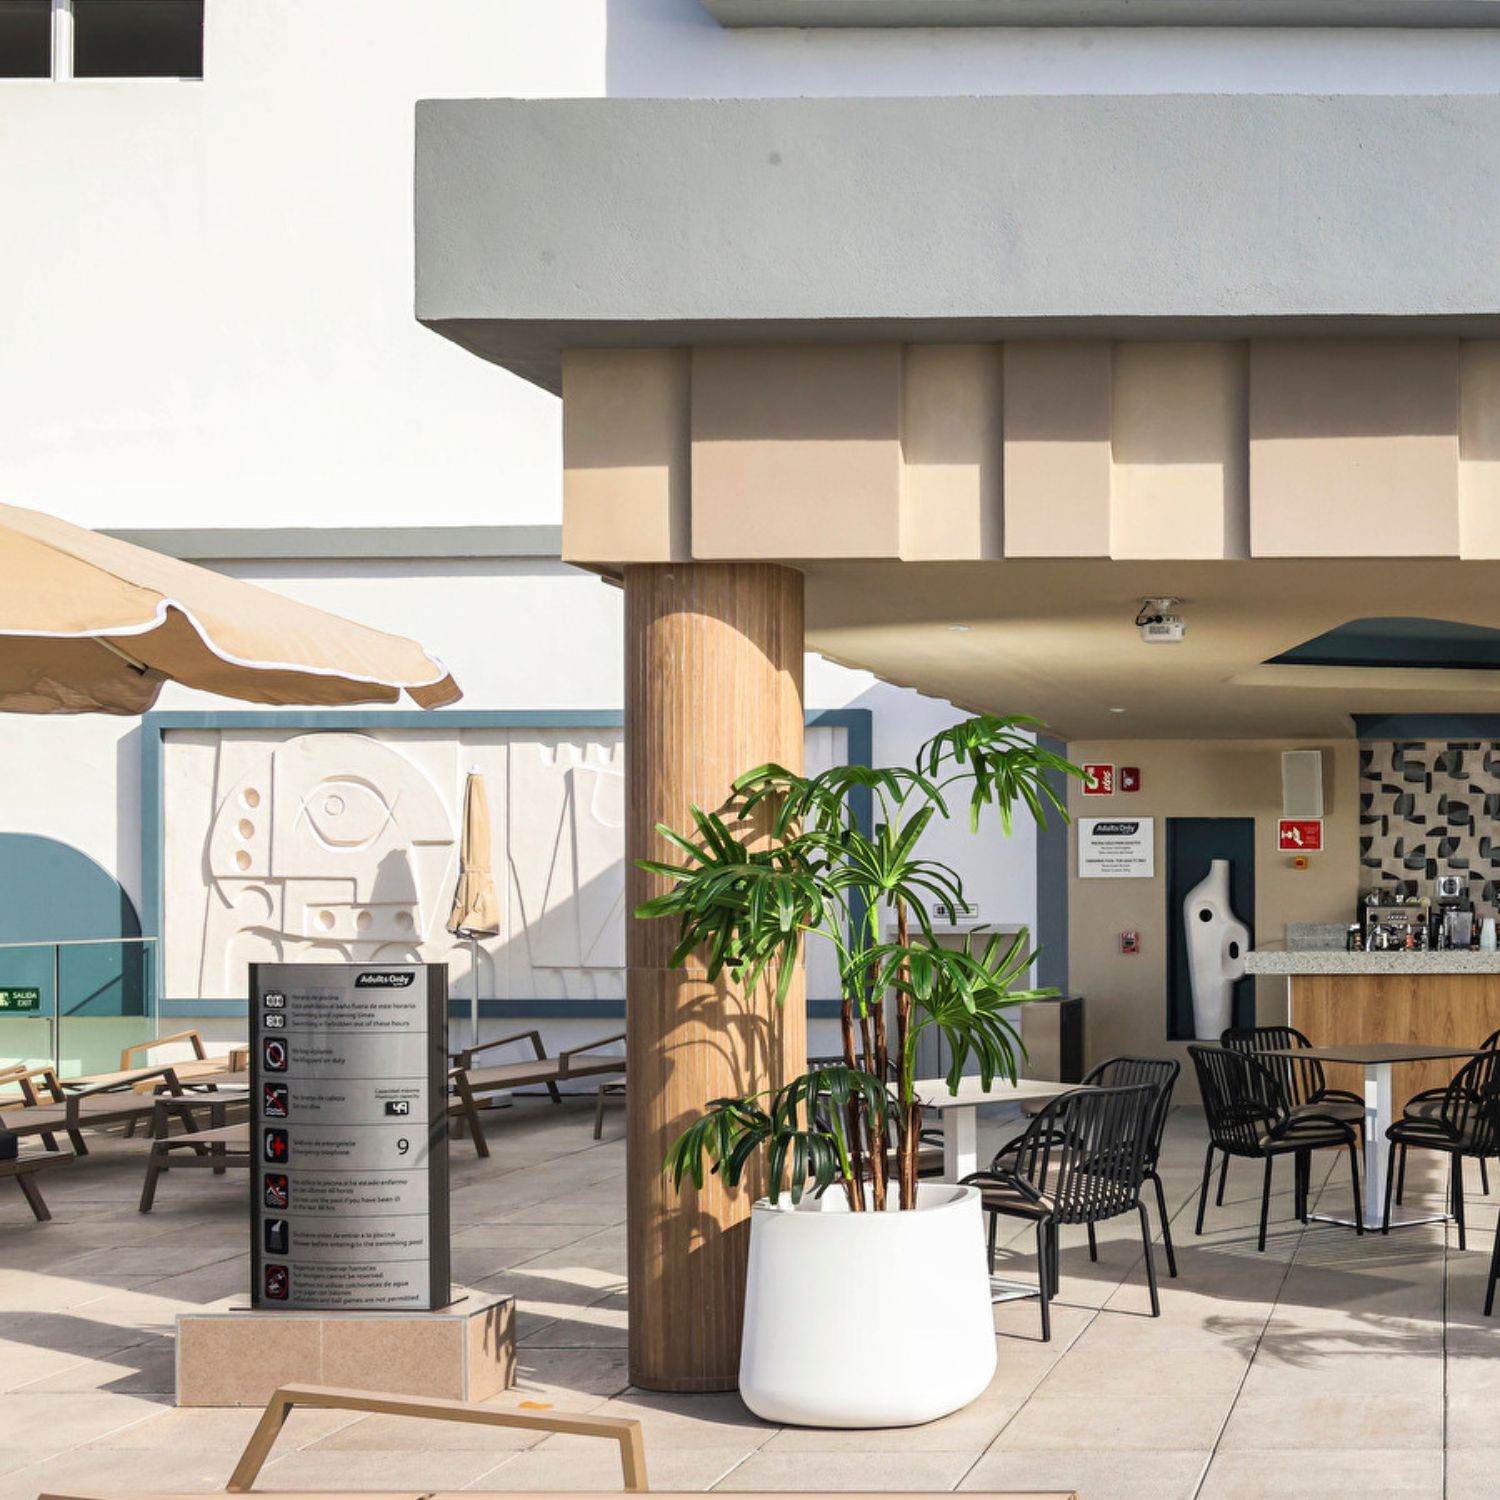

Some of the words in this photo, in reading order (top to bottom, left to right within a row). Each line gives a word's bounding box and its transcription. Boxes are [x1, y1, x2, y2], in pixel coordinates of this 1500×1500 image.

[360, 974, 387, 984] Adults
[389, 974, 409, 985] Only
[12, 991, 38, 999] SALIDA
[17, 999, 33, 1007] EXIT
[392, 1102, 408, 1114] 49
[397, 1138, 410, 1156] 9
